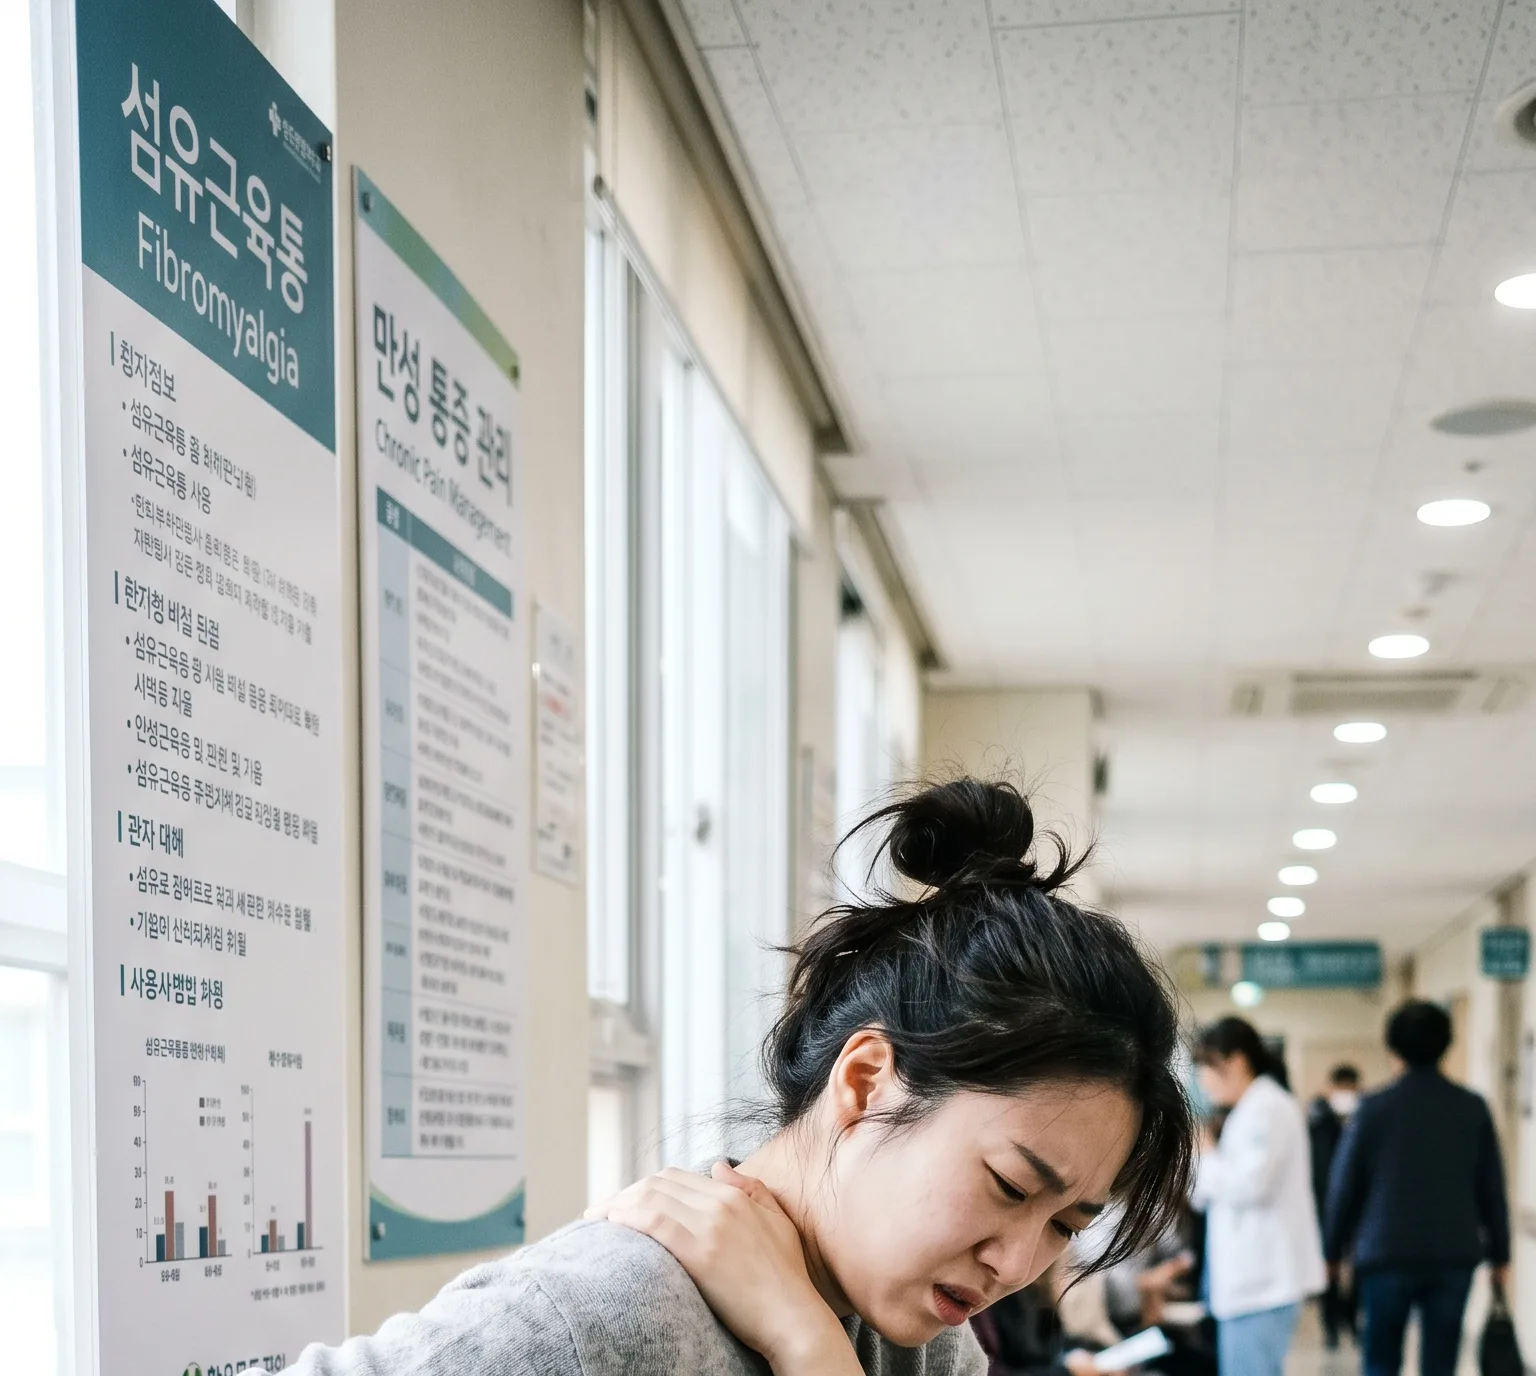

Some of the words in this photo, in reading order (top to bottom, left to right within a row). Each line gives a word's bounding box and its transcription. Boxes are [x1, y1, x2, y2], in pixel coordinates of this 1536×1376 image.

[121, 63, 308, 314] 섬유근육통
[138, 211, 300, 389] Fibromyalgia
[373, 303, 421, 424] 만성
[429, 356, 471, 468] 통증
[375, 418, 421, 485] Chronic
[422, 456, 447, 504] Pain
